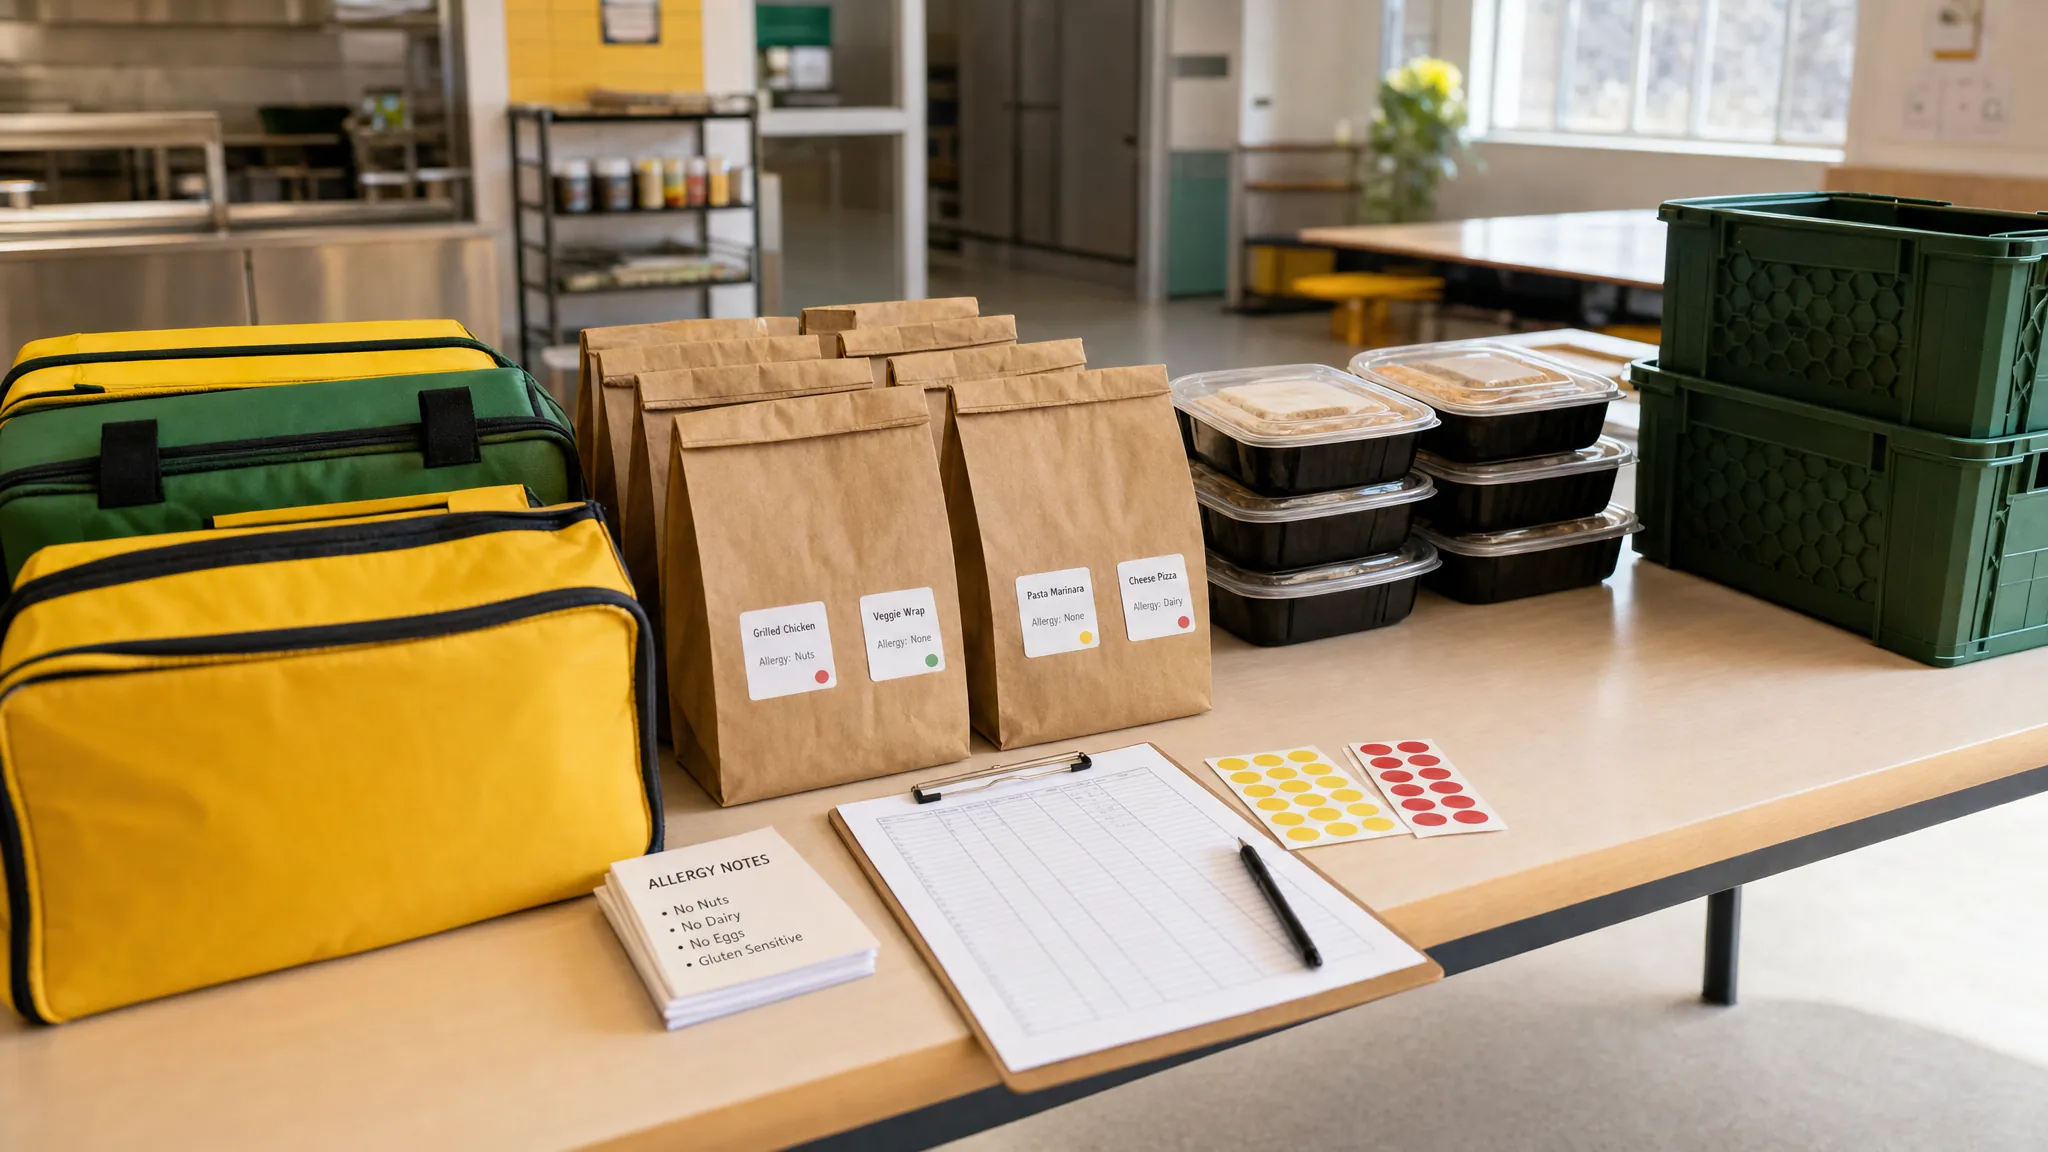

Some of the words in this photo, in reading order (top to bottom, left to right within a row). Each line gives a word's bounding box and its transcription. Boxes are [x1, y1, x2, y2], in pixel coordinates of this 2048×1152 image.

[1129, 575, 1156, 586] Cheese
[1158, 571, 1178, 582] Pizza
[1027, 590, 1049, 601] Pasta
[1051, 585, 1085, 597] Marinara
[1133, 601, 1161, 612] Allergy:
[1164, 596, 1183, 608] Dairy
[873, 609, 902, 623] Veggie
[903, 607, 926, 618] Wrap
[1031, 616, 1061, 627] Allergy:
[1064, 612, 1085, 623] None
[754, 625, 781, 638] Grilled
[784, 622, 816, 634] Chicken
[877, 638, 908, 650] Allergy:
[911, 634, 932, 644] None
[758, 655, 792, 667] Allergy:
[795, 650, 816, 661] Nuts
[649, 865, 714, 889] ALLERGY
[720, 854, 769, 873] NOTES
[674, 905, 694, 915] No
[697, 897, 729, 909] Nuts
[681, 921, 701, 932] No
[705, 912, 740, 926] Dairy
[690, 938, 710, 949] No
[713, 930, 745, 945] Eggs
[698, 949, 743, 967] Gluten
[745, 933, 804, 955] Sensitive
